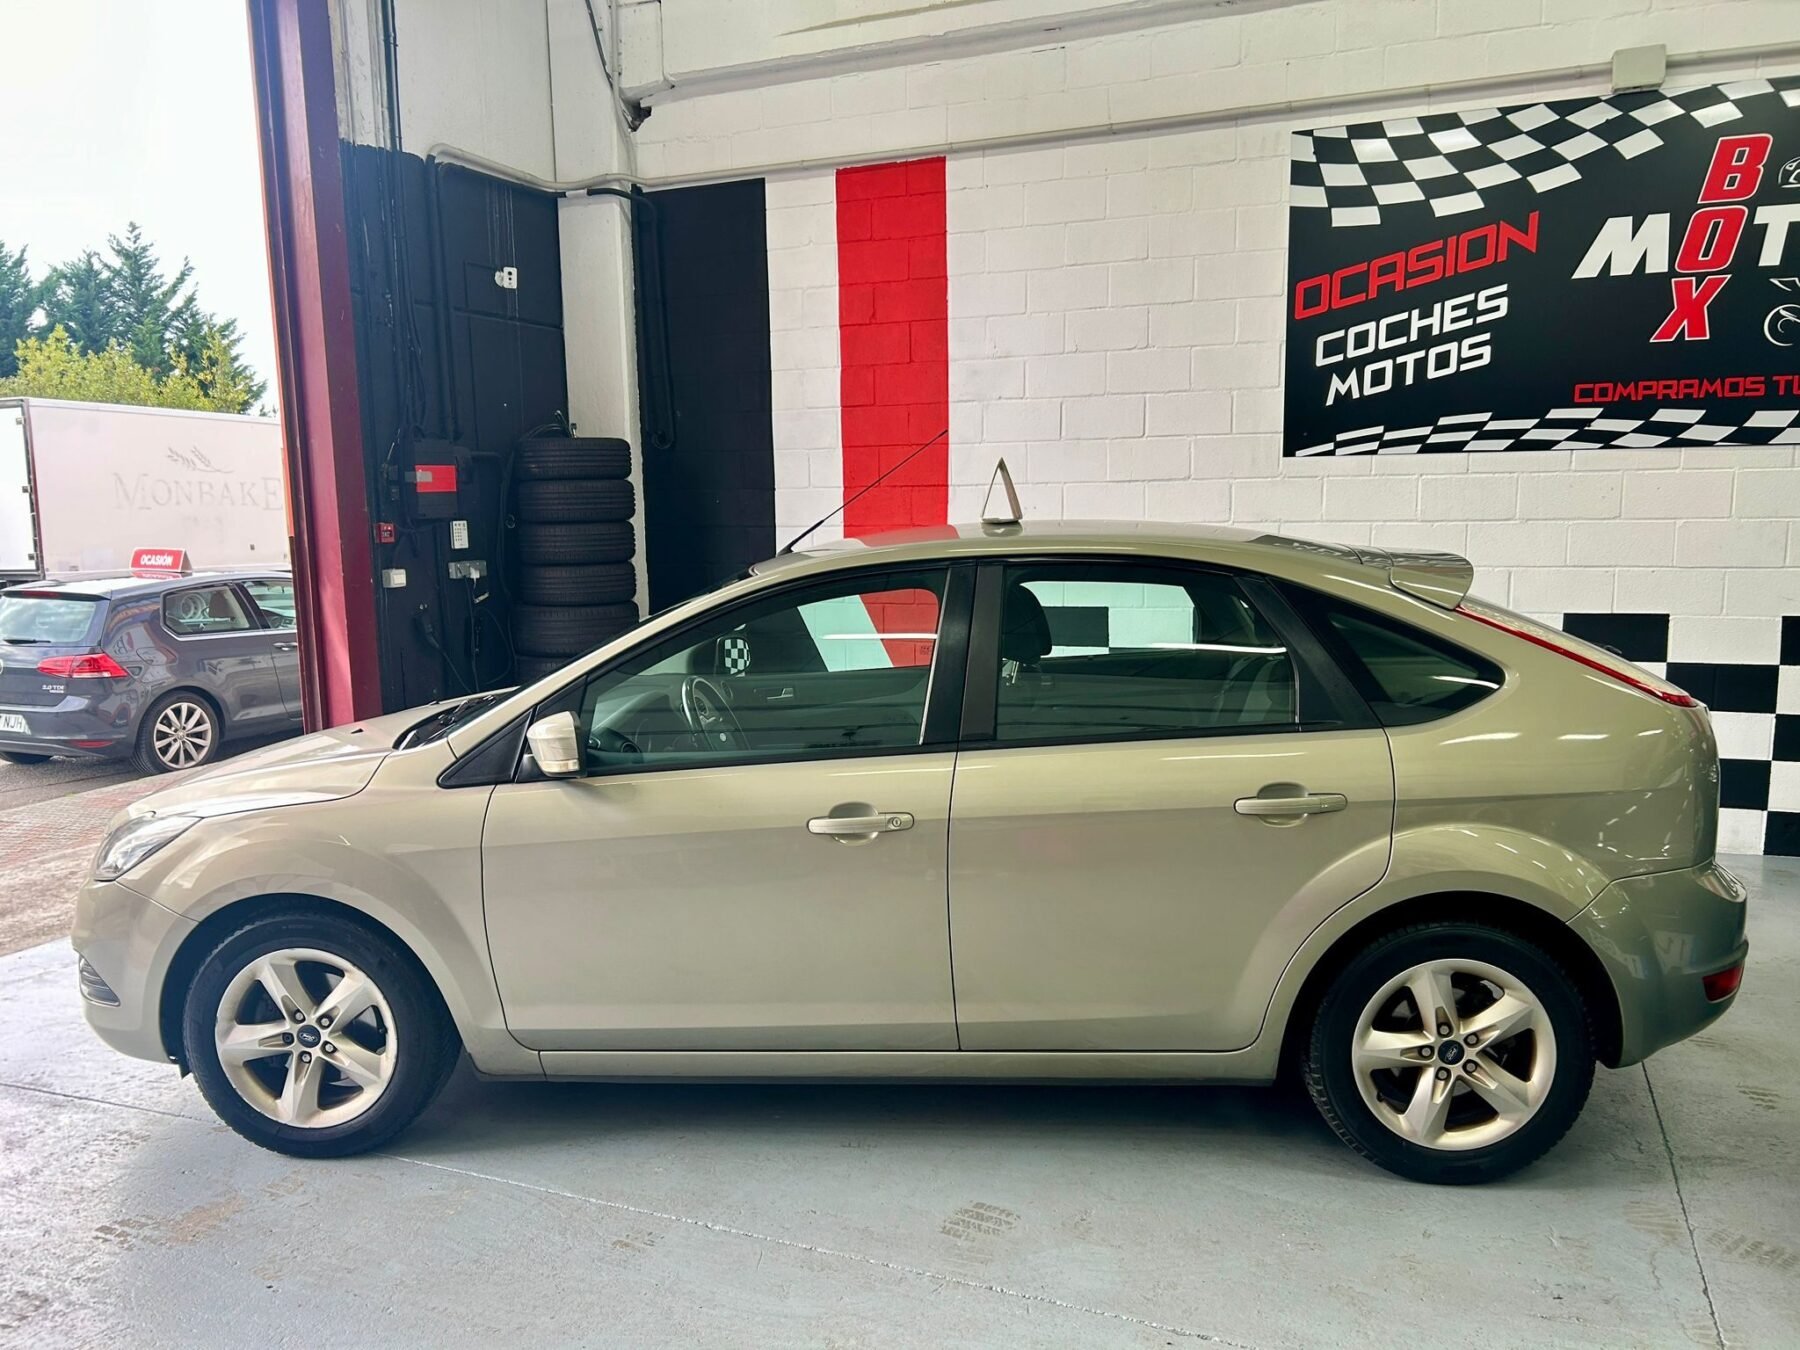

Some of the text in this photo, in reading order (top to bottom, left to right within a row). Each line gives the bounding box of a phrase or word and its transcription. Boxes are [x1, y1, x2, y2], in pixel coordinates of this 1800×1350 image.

[1294, 210, 1540, 320] OCASION
[1315, 283, 1509, 367] COCHES
[1325, 332, 1491, 406] MOTOS
[1574, 376, 1765, 403] COMPRAMOS
[140, 553, 173, 566] OCASIÓN
